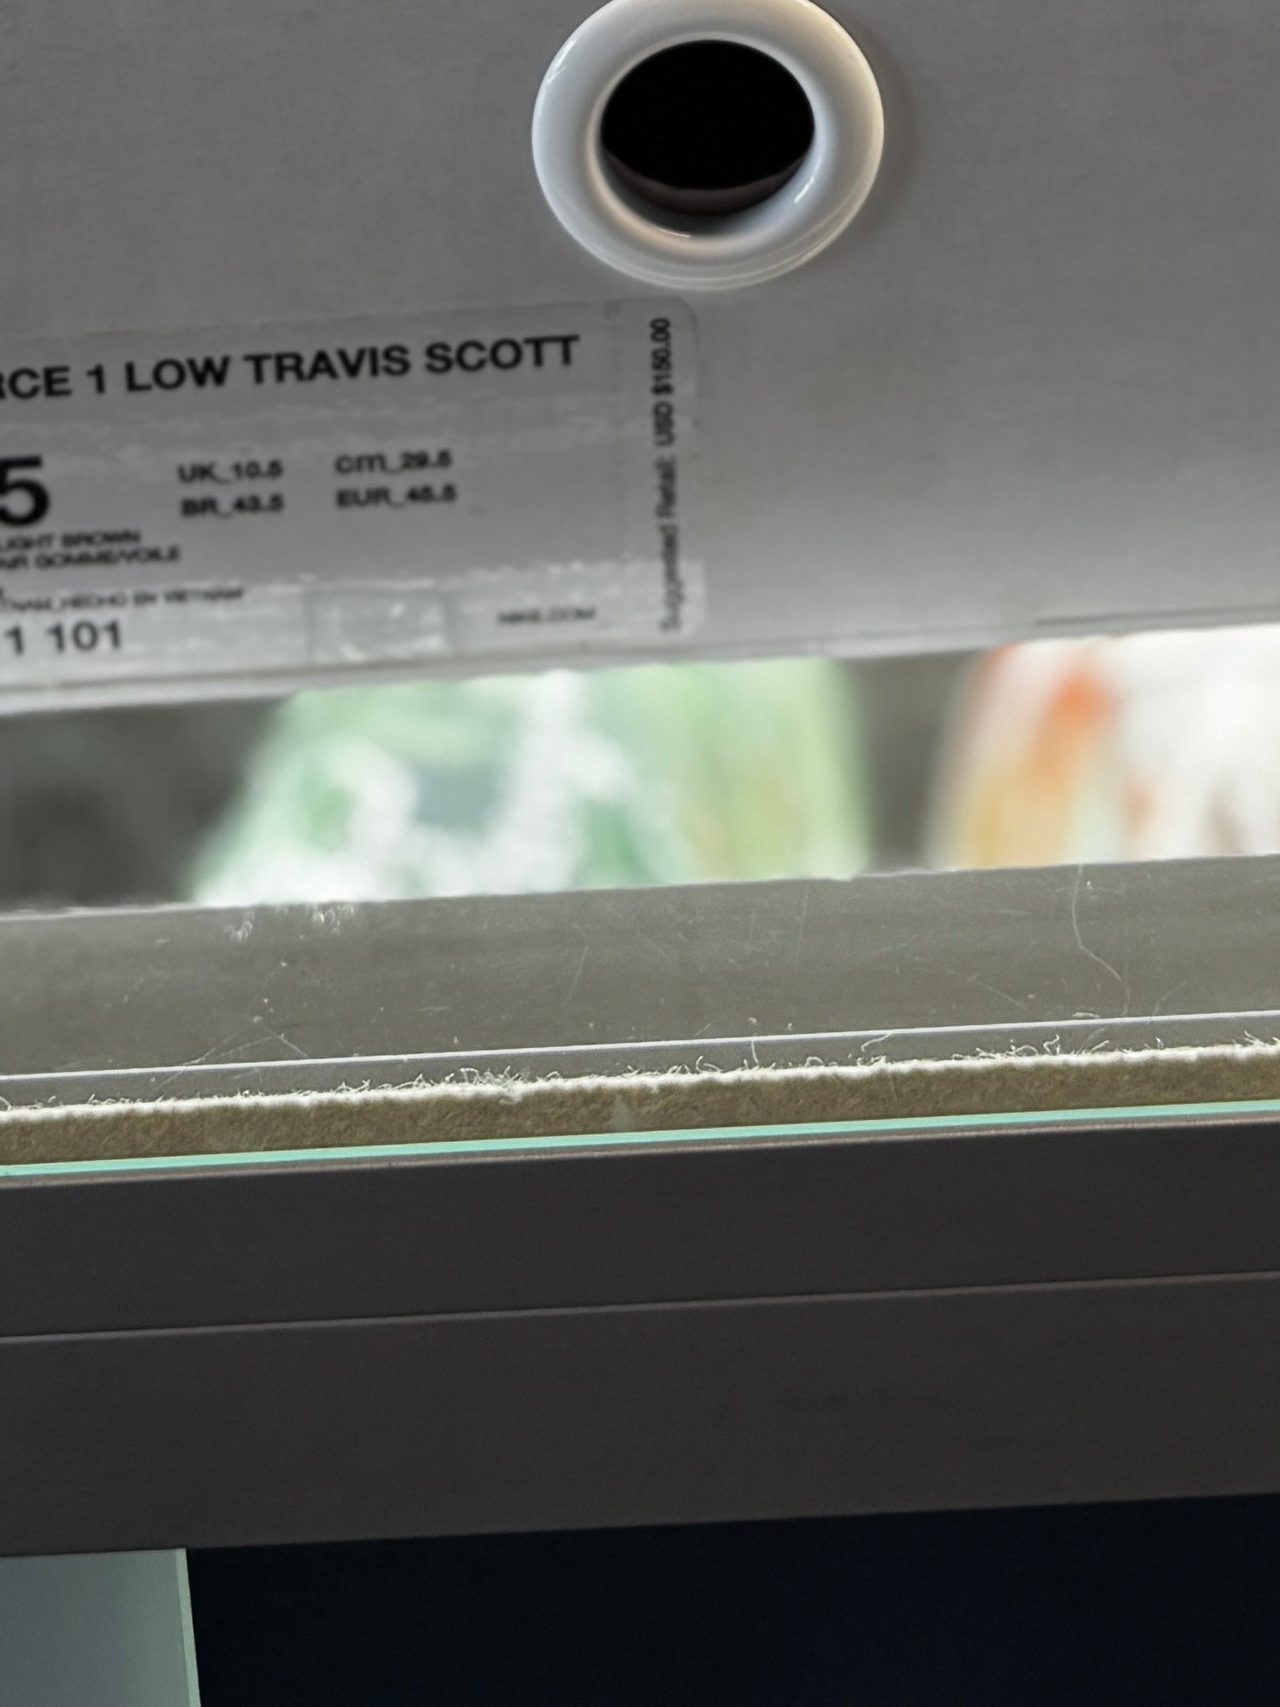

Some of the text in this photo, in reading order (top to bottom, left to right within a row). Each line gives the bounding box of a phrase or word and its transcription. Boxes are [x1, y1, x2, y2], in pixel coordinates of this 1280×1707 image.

[86, 363, 106, 394] 1
[124, 356, 232, 393] LOW
[244, 344, 412, 384] TRAVIS
[424, 334, 581, 374] SCOTT
[650, 317, 675, 396] $150.00
[653, 401, 676, 448] USD
[178, 458, 283, 484] UK_10.5
[180, 494, 284, 517] BR_43.5
[61, 529, 142, 549] BROWN
[45, 619, 122, 653] 101
